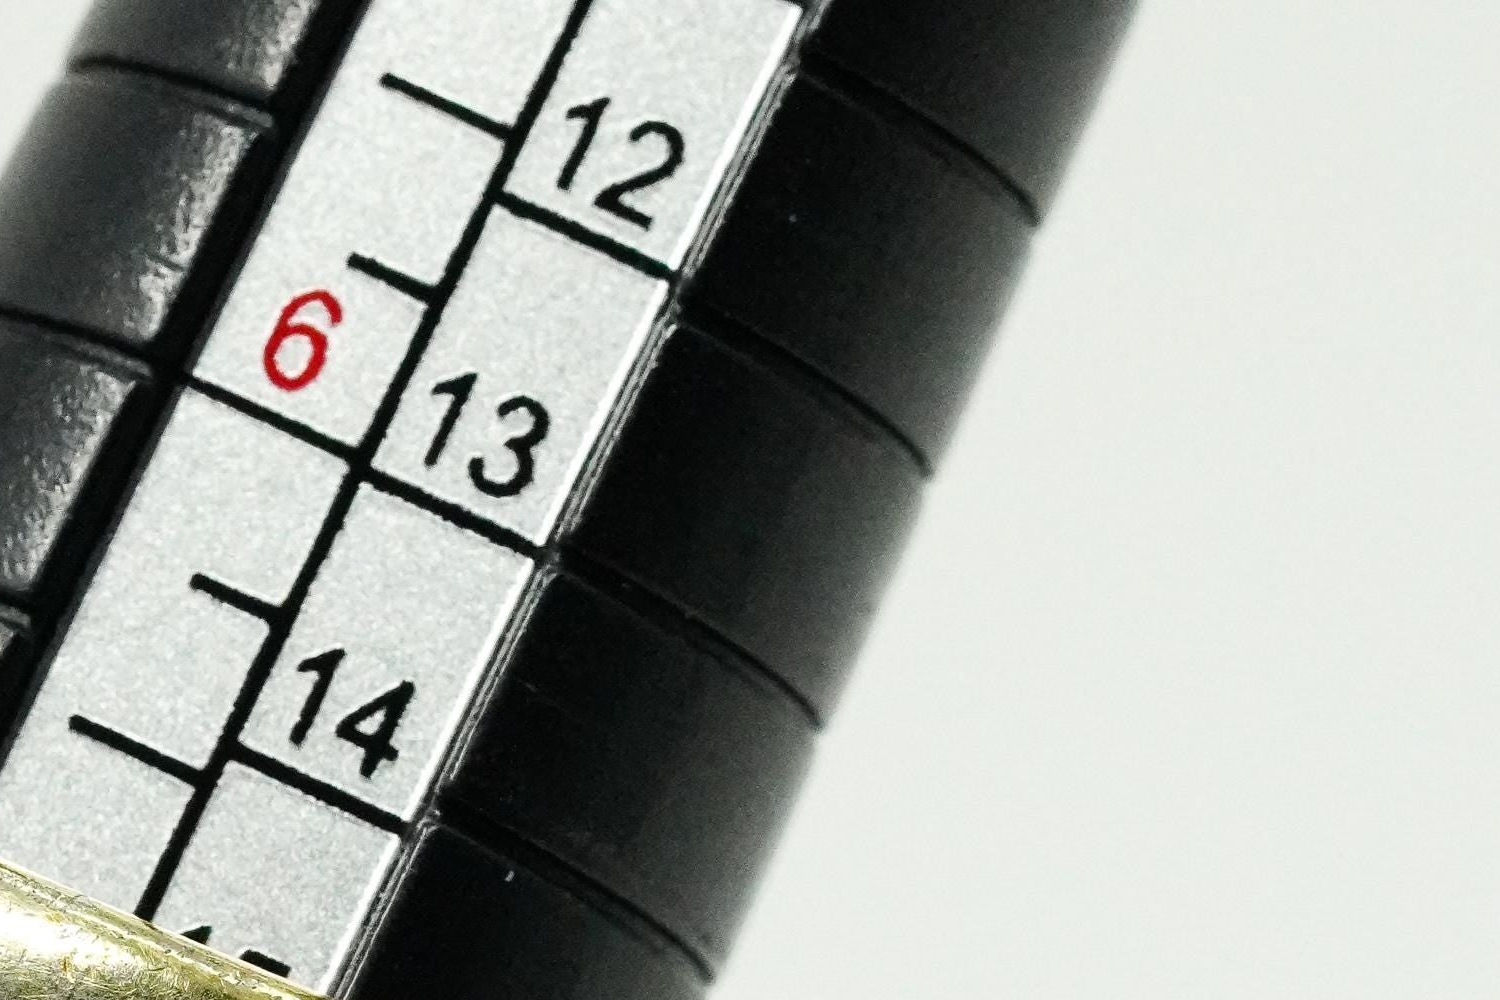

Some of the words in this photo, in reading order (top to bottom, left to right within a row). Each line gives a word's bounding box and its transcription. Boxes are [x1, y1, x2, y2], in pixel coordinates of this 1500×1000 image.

[557, 97, 685, 231] 12
[263, 290, 343, 392] 6
[424, 373, 551, 499] 13
[289, 648, 415, 779] 14
